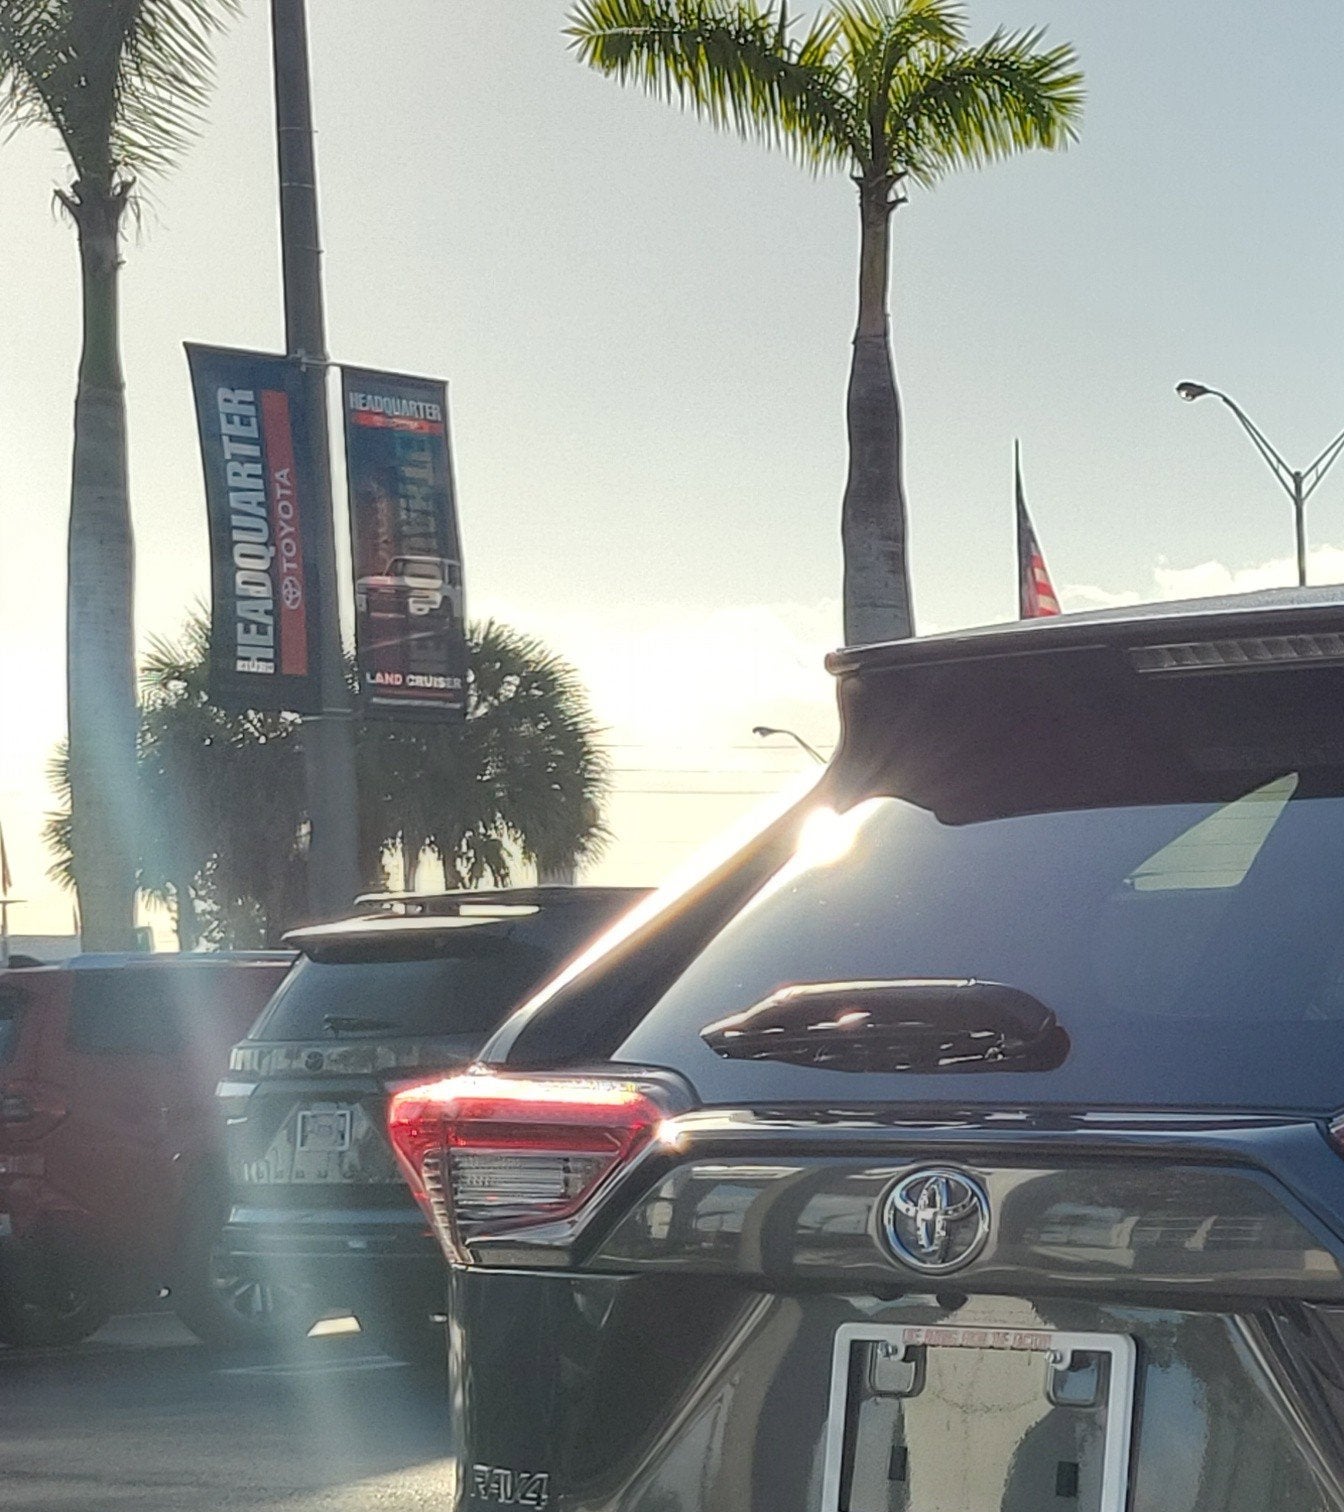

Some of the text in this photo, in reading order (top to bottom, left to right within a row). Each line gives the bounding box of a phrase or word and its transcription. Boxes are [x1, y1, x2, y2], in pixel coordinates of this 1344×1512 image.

[349, 391, 443, 422] HEADQUARTER
[217, 387, 275, 674] HEADQUARTER
[275, 468, 300, 575] TOYOTA
[366, 671, 462, 689] LAND CRUISER
